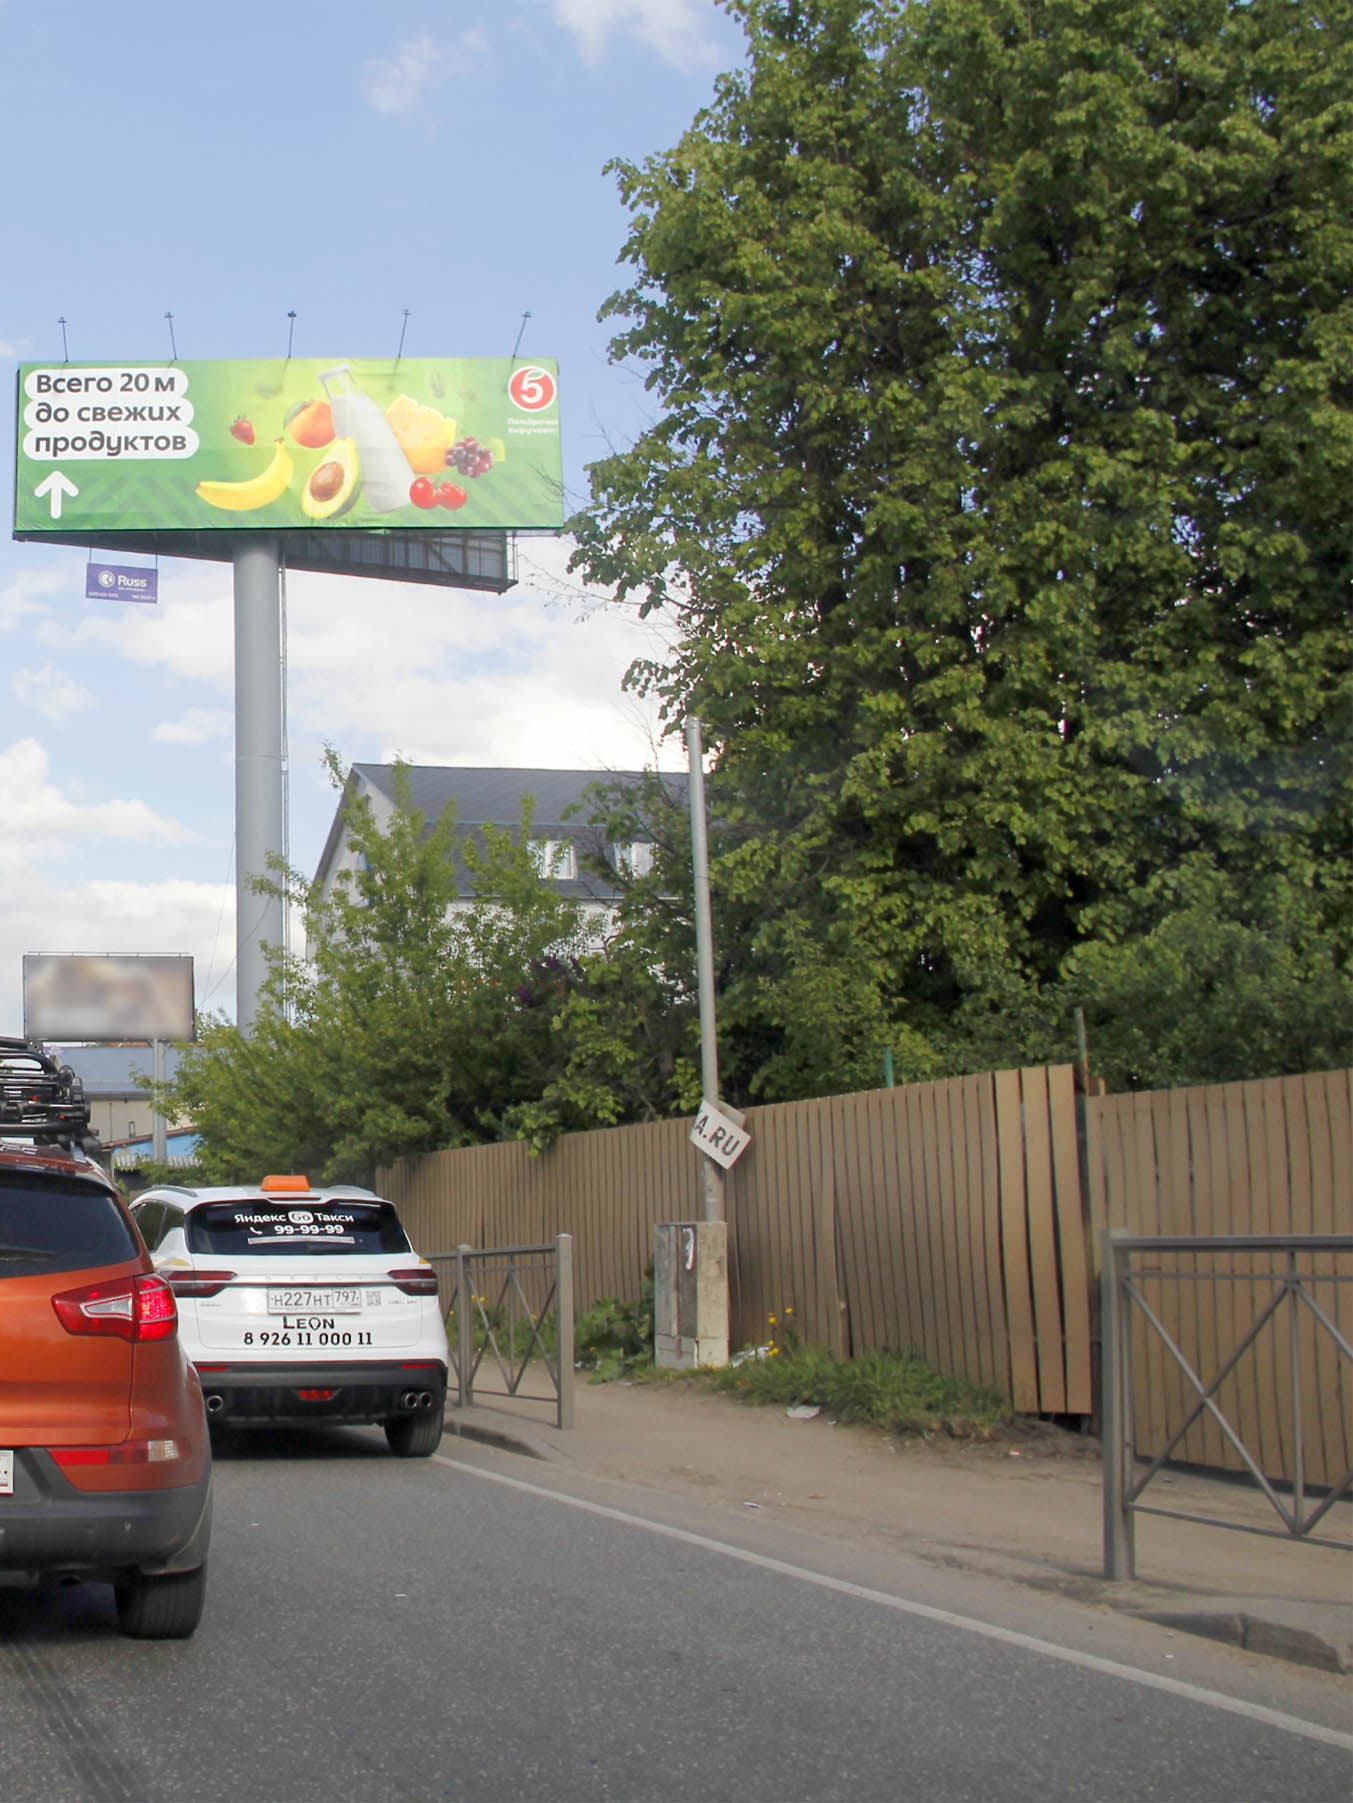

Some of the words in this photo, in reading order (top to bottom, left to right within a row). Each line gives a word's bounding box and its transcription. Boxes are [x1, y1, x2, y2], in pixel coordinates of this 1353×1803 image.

[36, 374, 113, 394] Всего
[119, 373, 150, 393] 20
[154, 376, 176, 392] м
[35, 402, 70, 423] до
[77, 405, 182, 422] свежих
[35, 430, 188, 457] продуктов
[117, 575, 147, 588] Russ
[234, 1213, 288, 1223] Яндекс
[314, 1212, 355, 1222] Такси
[274, 1225, 345, 1235] 99-99-99
[244, 1332, 254, 1345] 8
[260, 1332, 292, 1346] 926
[297, 1333, 313, 1346] 11
[319, 1332, 352, 1346] 000
[358, 1332, 373, 1345] 11
